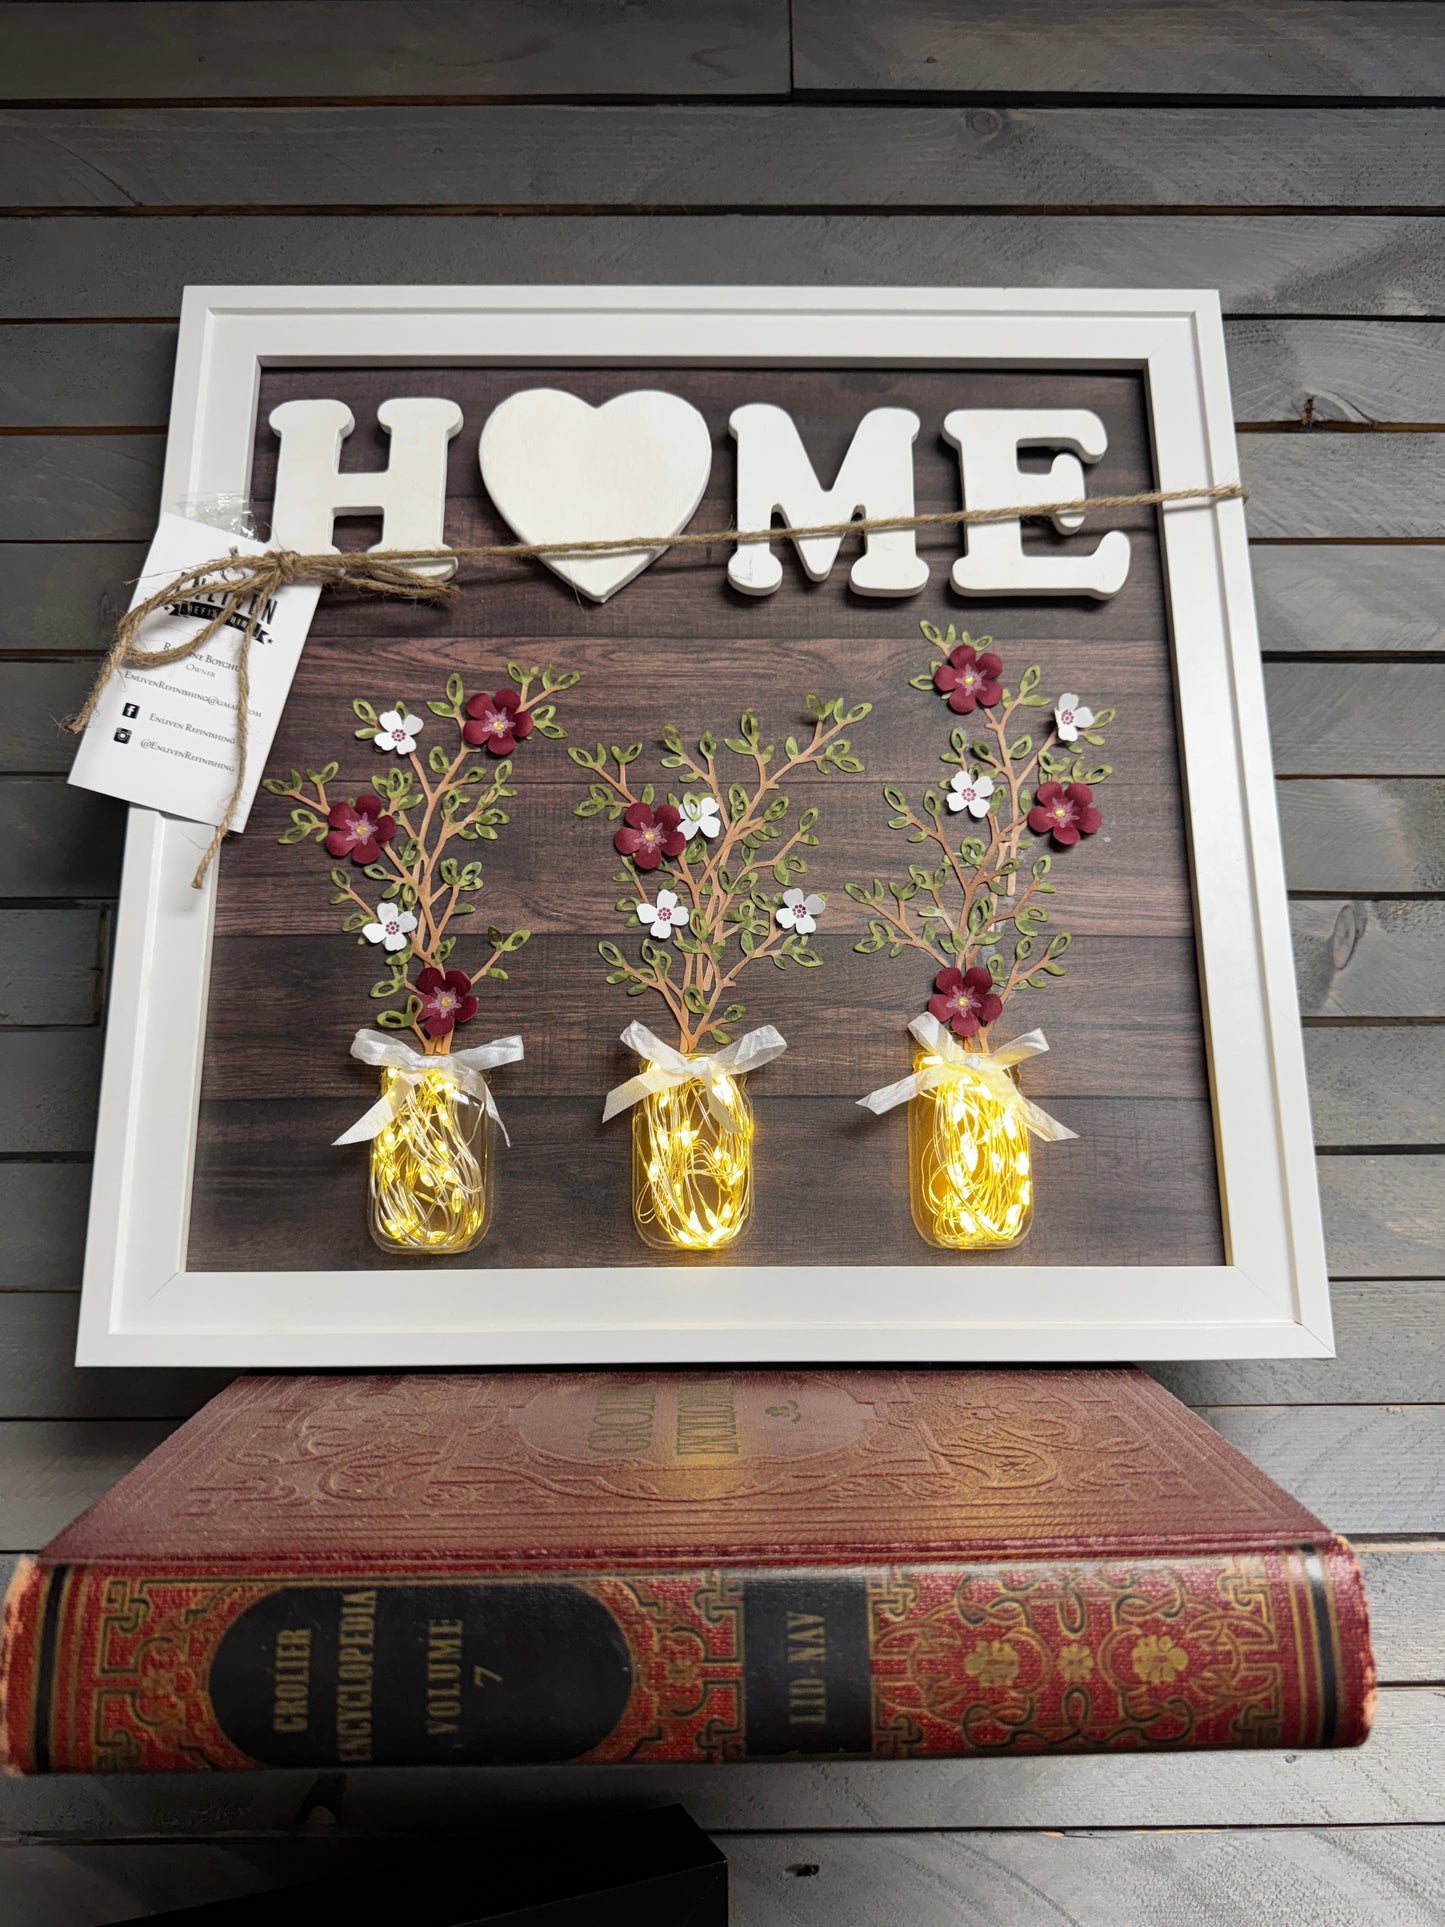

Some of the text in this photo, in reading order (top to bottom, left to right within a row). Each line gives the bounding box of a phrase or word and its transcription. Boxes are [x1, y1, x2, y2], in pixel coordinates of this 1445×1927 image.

[272, 1626, 313, 1734] GROLIER
[336, 1590, 378, 1762] ENCYCLOPEDIA
[426, 1617, 464, 1737] VOLUME
[473, 1666, 504, 1689] 7
[788, 1610, 827, 1726] LID-NAV
